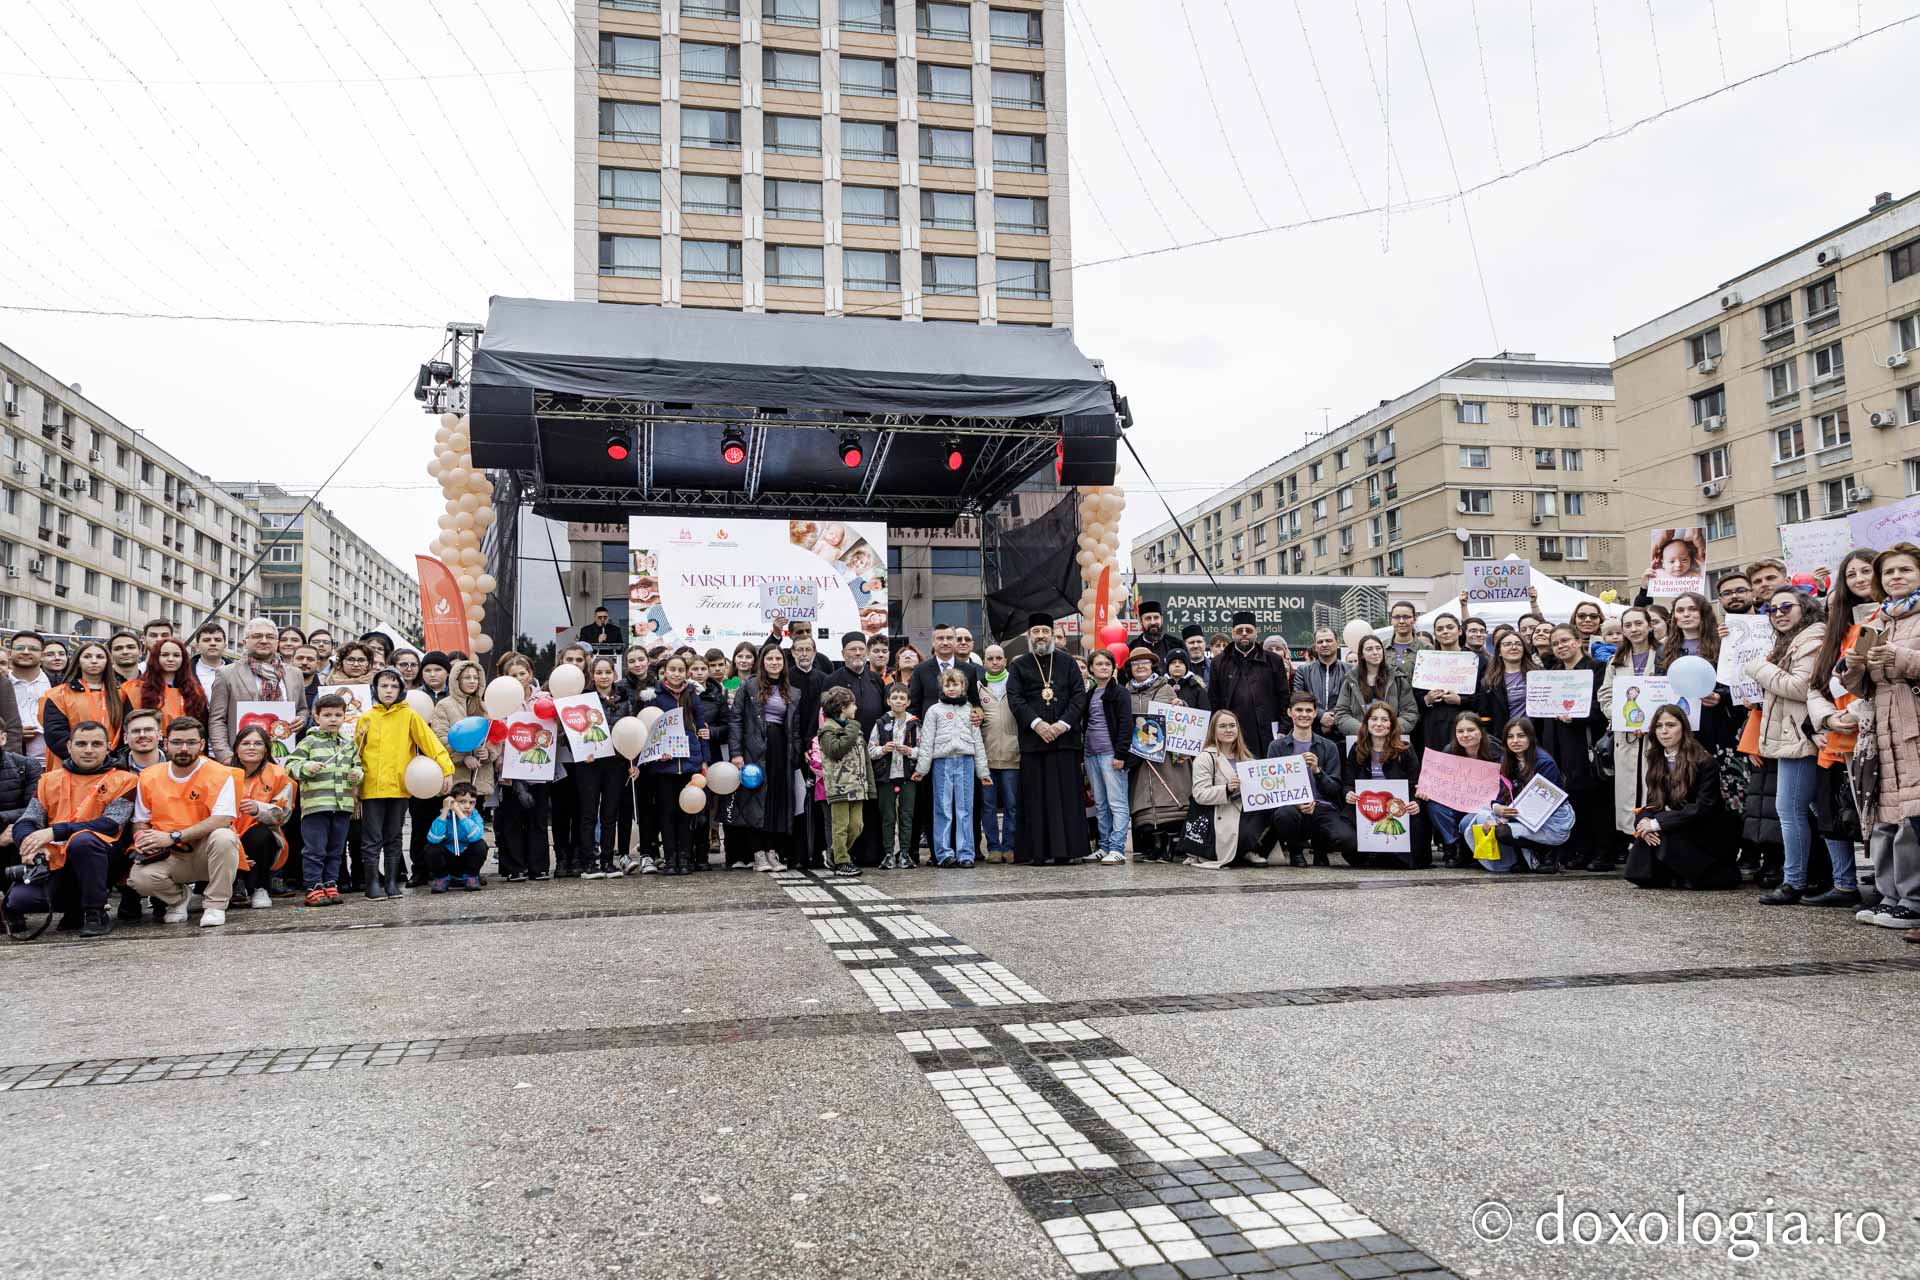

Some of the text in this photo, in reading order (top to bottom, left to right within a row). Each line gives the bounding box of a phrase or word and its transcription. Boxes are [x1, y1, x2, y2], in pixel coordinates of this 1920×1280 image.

[1474, 565, 1525, 576] FIECARE
[681, 573, 740, 589] MARȘUL
[1484, 576, 1508, 588] OM
[769, 585, 813, 596] FIECARE
[696, 595, 744, 609] Fiecare
[777, 595, 799, 606] OM
[1167, 596, 1305, 609] APARTAMENTE NOI
[1167, 610, 1282, 625] 1, 2 și 3 CERE
[1221, 624, 1233, 633] de
[1263, 624, 1283, 633] Mall
[1248, 761, 1301, 778] FIECARE
[1260, 775, 1286, 791] OM
